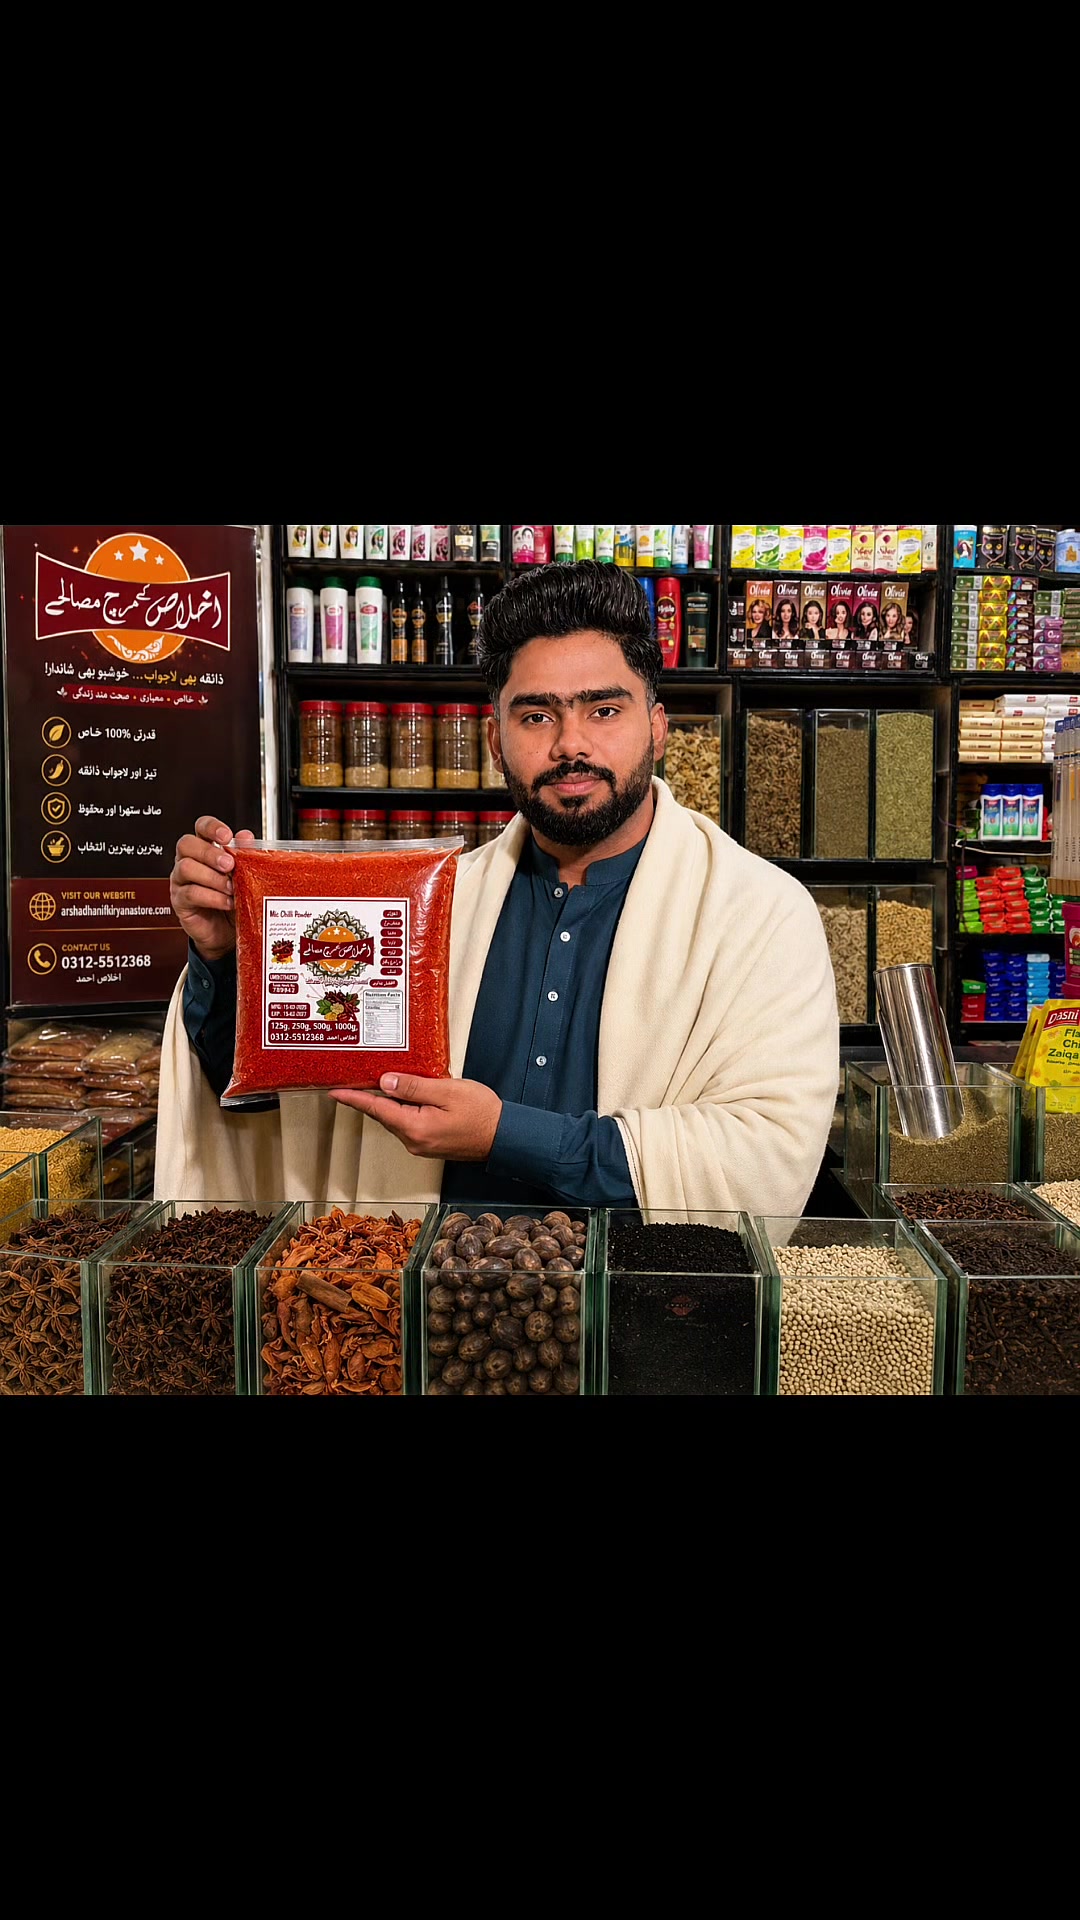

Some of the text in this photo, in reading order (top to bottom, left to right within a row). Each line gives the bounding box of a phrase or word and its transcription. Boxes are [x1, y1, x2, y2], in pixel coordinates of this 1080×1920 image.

[103, 591, 139, 624] مرچ
[145, 590, 221, 630] اخلاص
[97, 666, 129, 680] خوشبو
[173, 694, 194, 706] خالص
[133, 729, 156, 741] قدرتی
[102, 767, 128, 779] لاجواب
[130, 768, 141, 779] اور
[144, 769, 157, 780] تیز
[78, 803, 104, 816] محفوظ
[105, 805, 116, 816] اور
[143, 805, 161, 815] صاف
[61, 892, 135, 900] VISIT OUR WEBSITE
[61, 905, 171, 918] arshadhanifkiryanastore.com
[61, 955, 151, 969] 0312-5512368
[76, 973, 121, 984] اخلاص احمد
